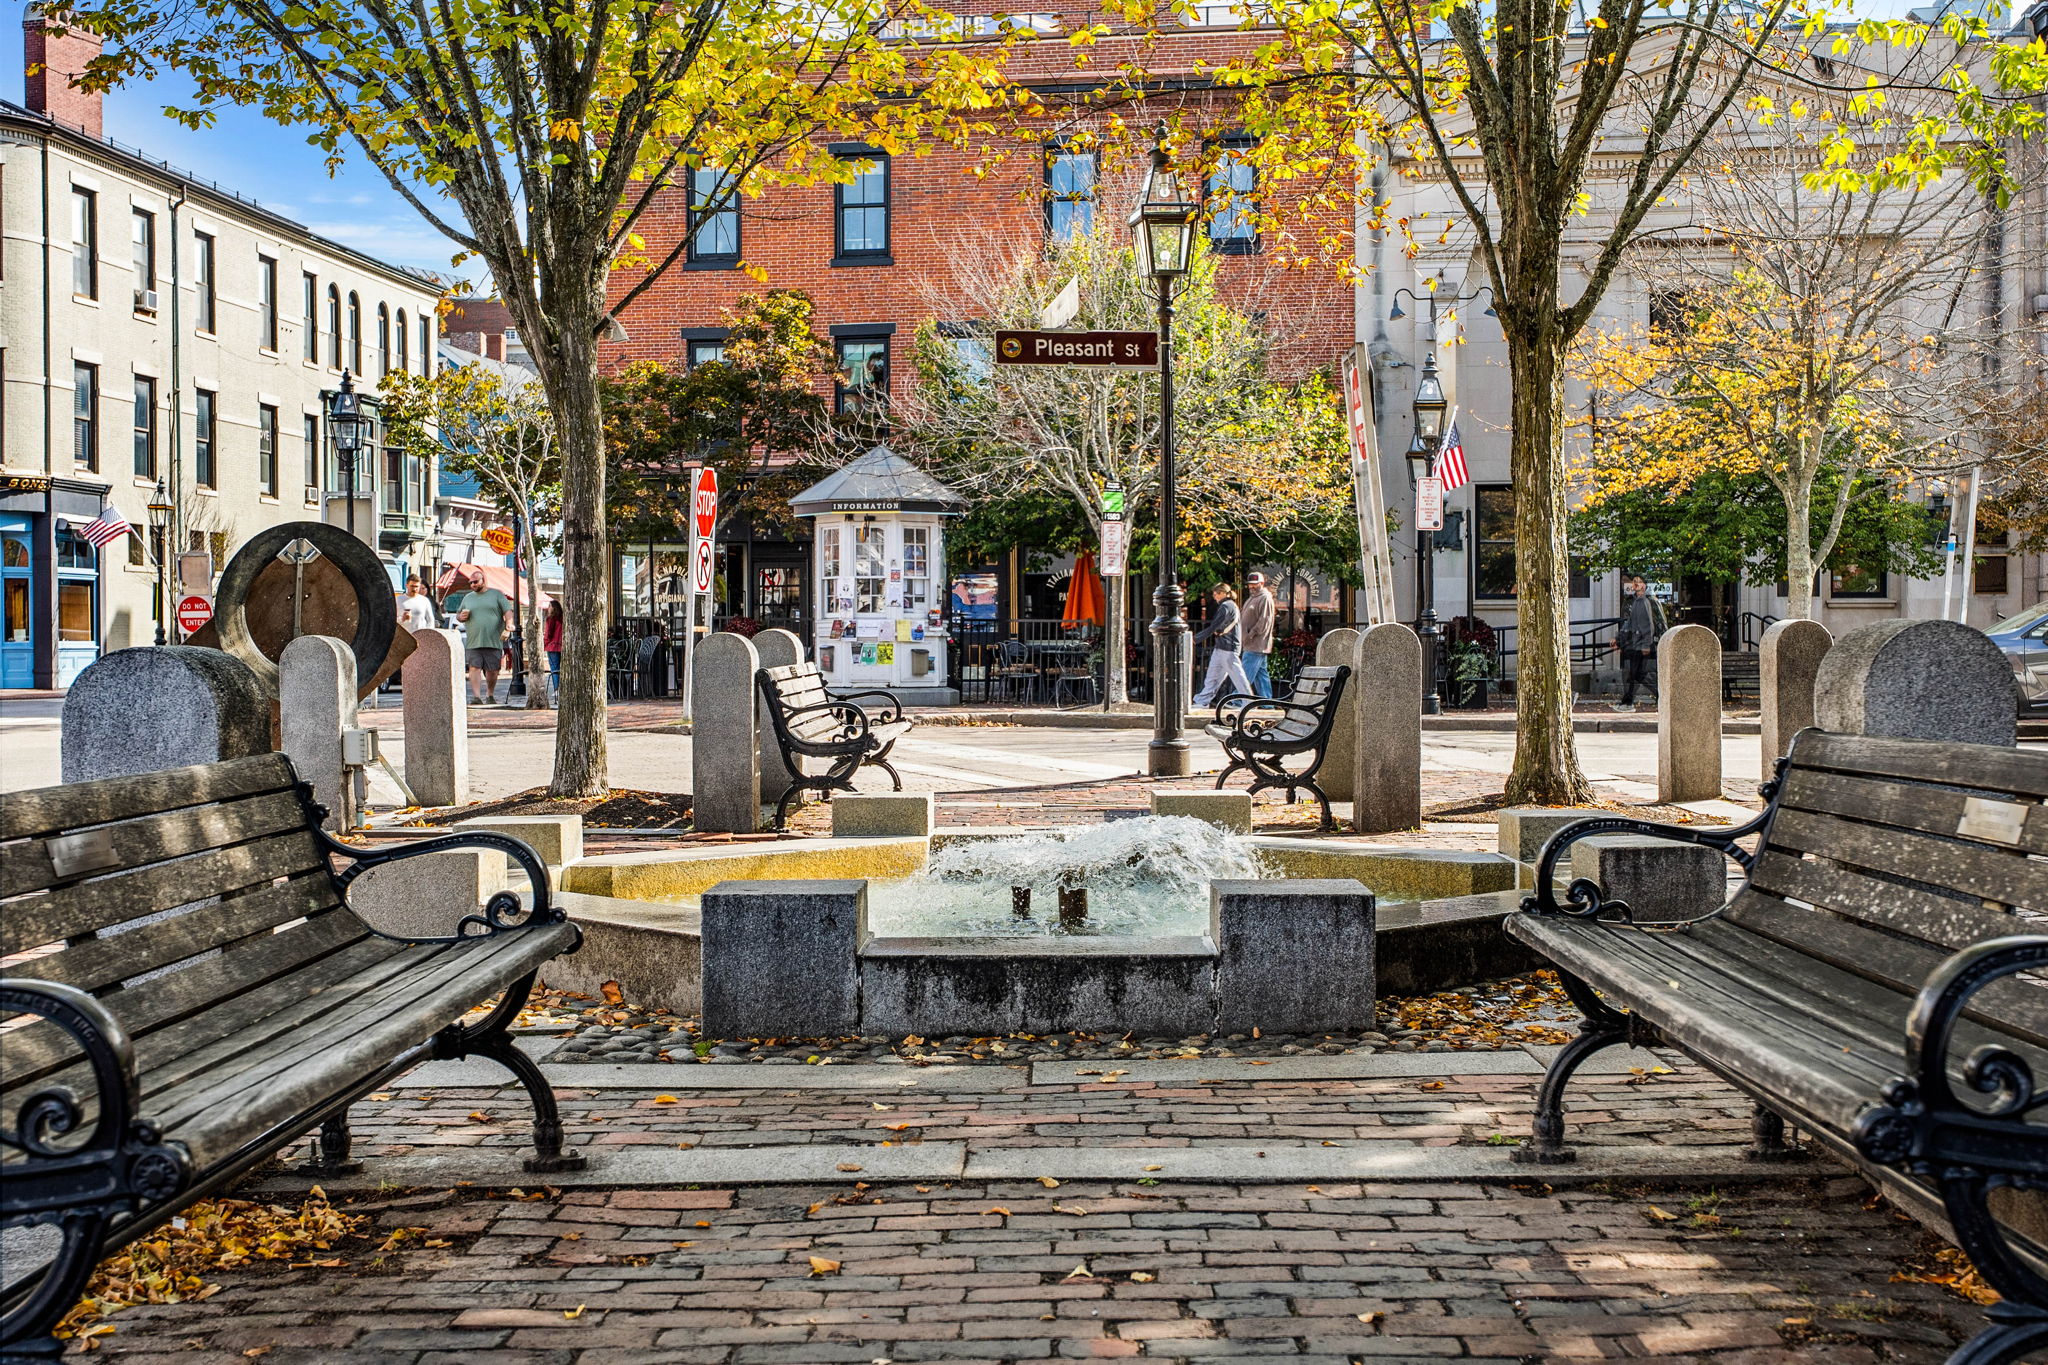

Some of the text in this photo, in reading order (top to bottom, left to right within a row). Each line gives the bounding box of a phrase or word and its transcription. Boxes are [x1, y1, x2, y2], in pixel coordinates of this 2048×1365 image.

[1035, 338, 1140, 357] Pleasant St
[697, 490, 715, 517] STOP
[1059, 592, 1069, 601] PA
